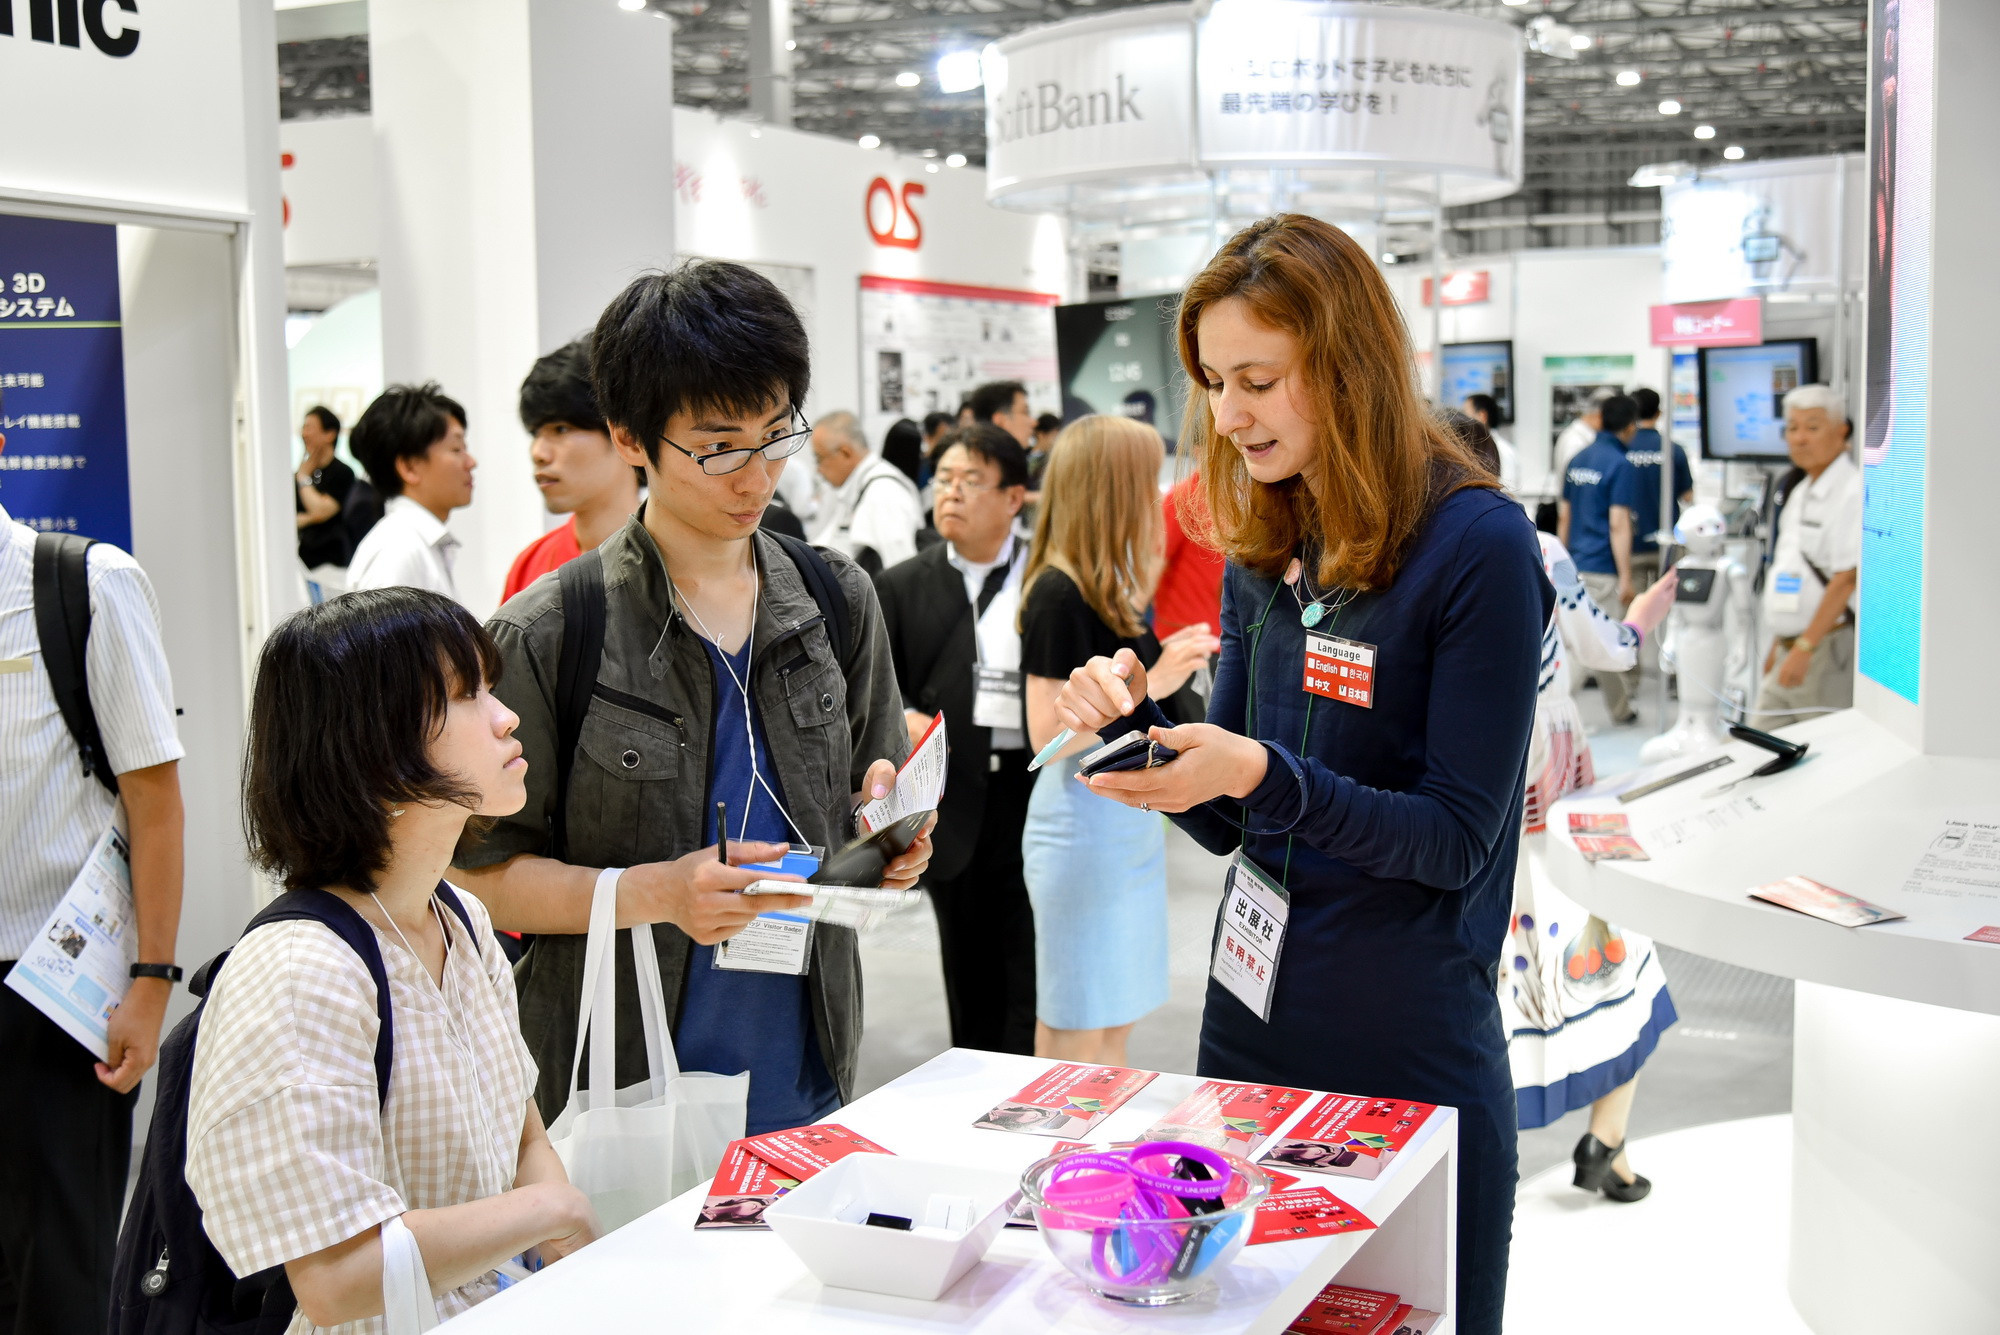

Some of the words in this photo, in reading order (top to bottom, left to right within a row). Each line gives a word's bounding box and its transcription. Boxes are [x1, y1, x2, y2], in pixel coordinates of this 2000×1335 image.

[12, 272, 46, 294] 3D
[1317, 641, 1361, 662] Language
[1315, 660, 1338, 675] English
[1349, 668, 1369, 683] 한국어
[1314, 678, 1331, 693] 中文
[1348, 687, 1369, 703] 日本語
[1234, 896, 1274, 941] 出展社
[1238, 922, 1263, 946] EXHIBITOR
[1225, 935, 1266, 981] 転用禁止
[1064, 1158, 1098, 1170] UNLIMITED
[1155, 1182, 1171, 1191] CITY
[1173, 1184, 1183, 1193] OF
[1184, 1186, 1221, 1195] UNLIMITED
